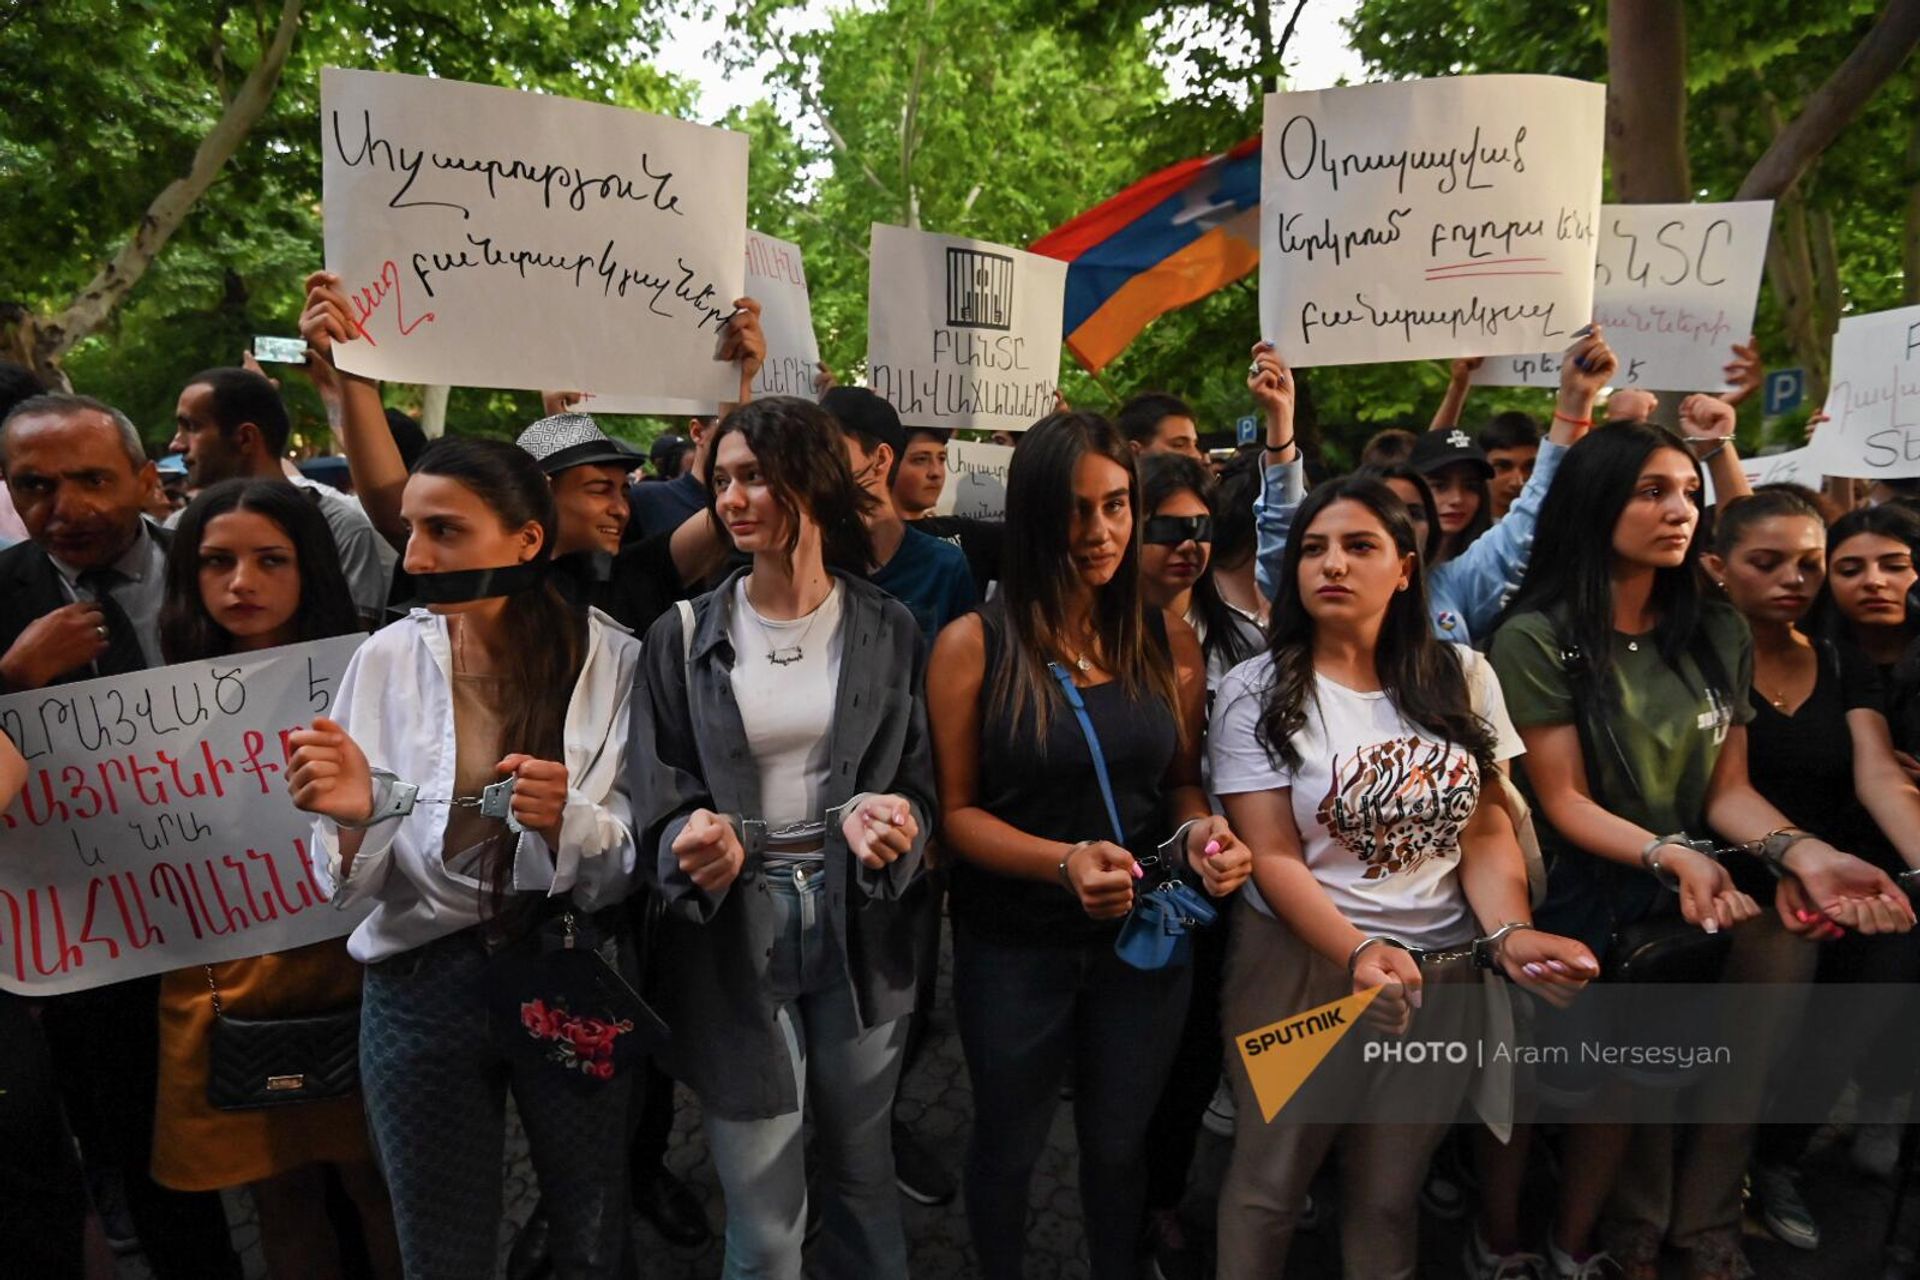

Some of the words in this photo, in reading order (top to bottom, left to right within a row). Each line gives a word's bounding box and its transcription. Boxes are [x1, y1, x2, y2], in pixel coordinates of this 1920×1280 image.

[1595, 219, 1732, 288] ՆՏԸ
[933, 329, 1030, 371] ԲԱՆՏԸ
[1773, 375, 1797, 410] P
[1242, 420, 1252, 439] P
[0, 667, 246, 761] ՂԹԱՅՎԱԾ
[0, 726, 303, 829] ԱՅՐԵՆԻՔ
